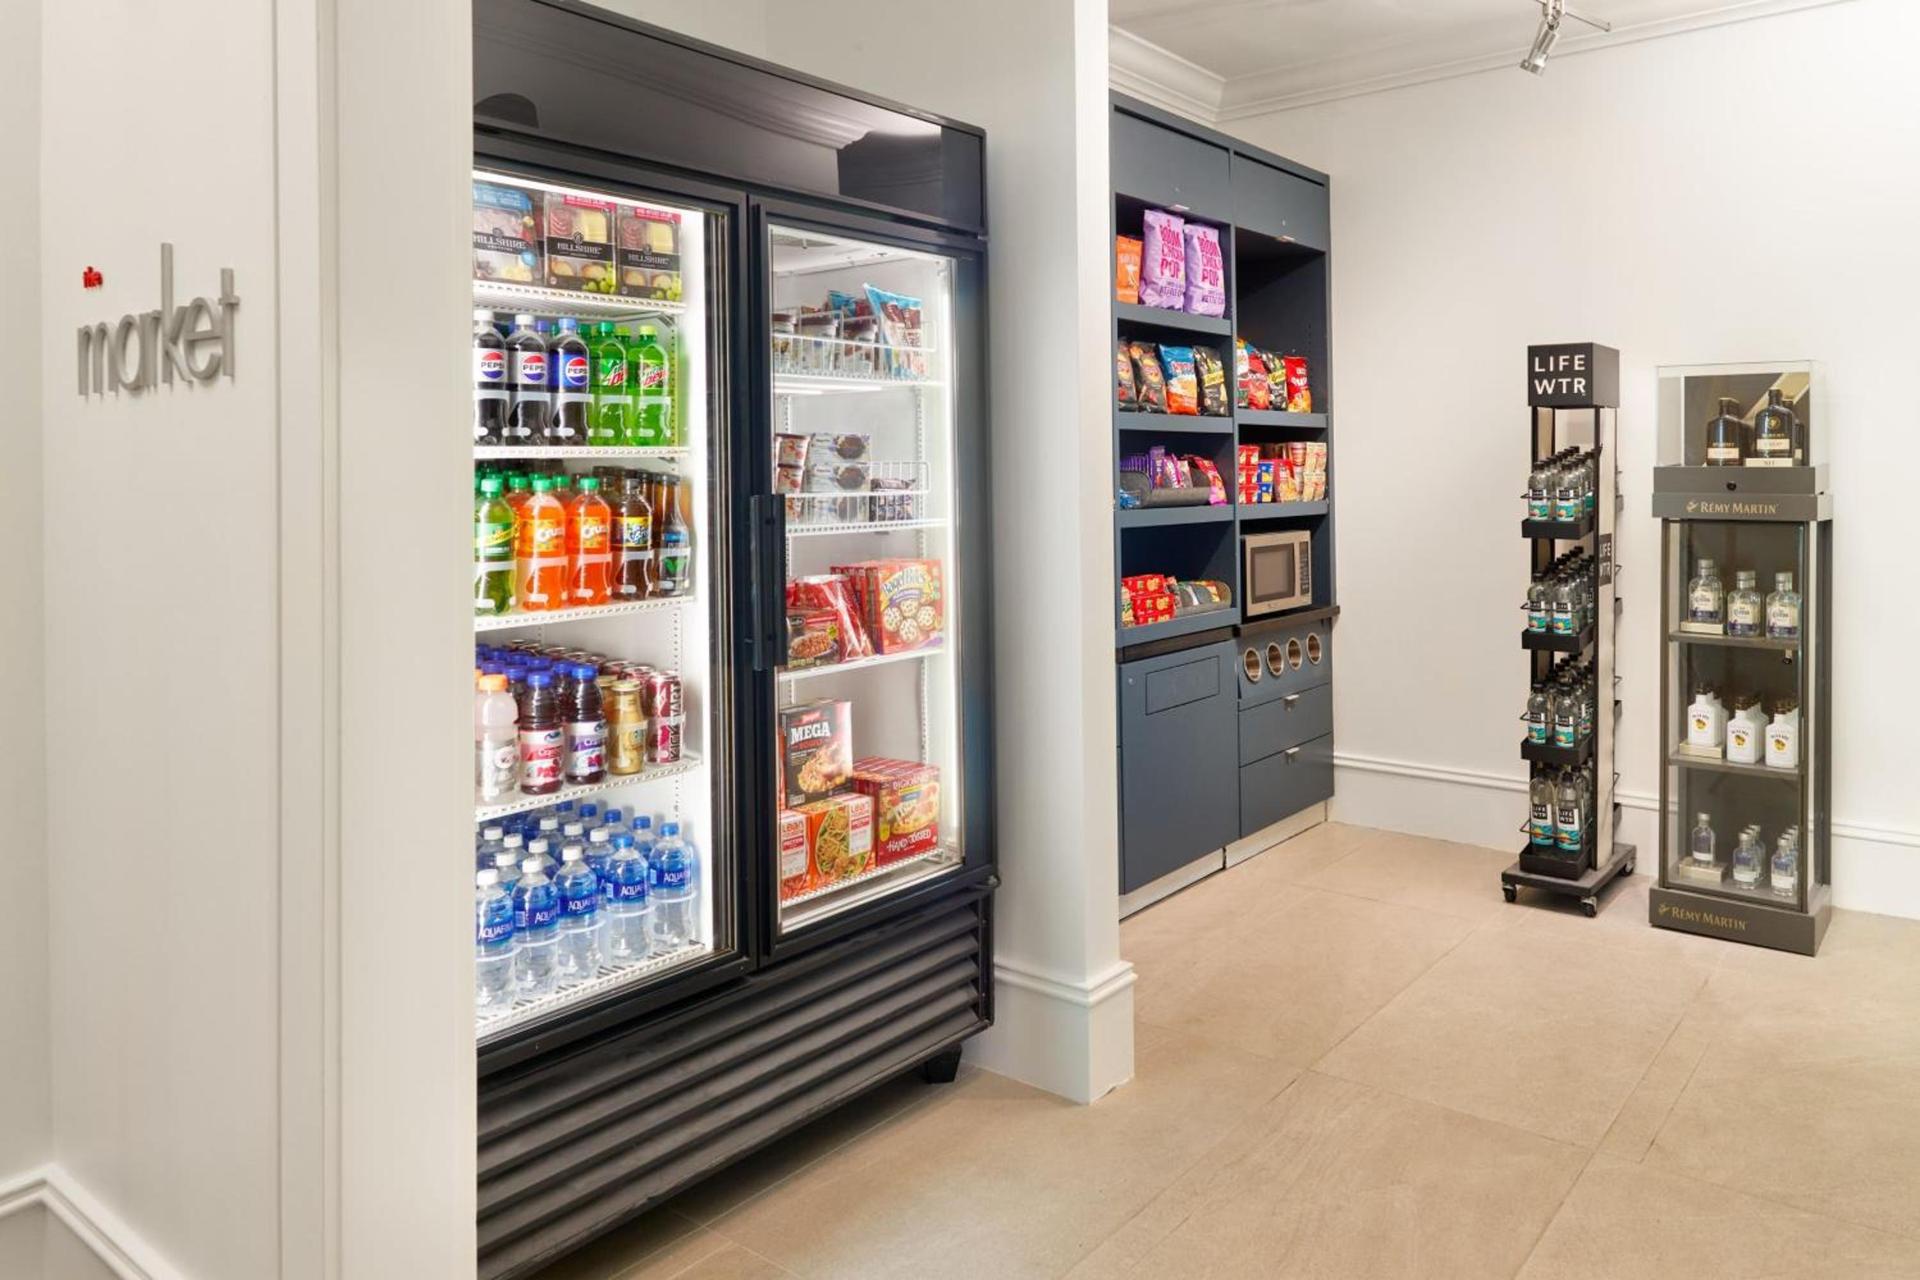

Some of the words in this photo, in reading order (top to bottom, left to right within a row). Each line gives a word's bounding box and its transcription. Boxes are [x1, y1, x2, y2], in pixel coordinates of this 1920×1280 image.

[78, 243, 240, 396] market
[480, 361, 505, 370] PEPS
[567, 367, 588, 375] PEPS
[1534, 354, 1586, 372] LIFE
[1534, 378, 1587, 395] WTR
[1700, 501, 1730, 513] RÉMY
[1732, 503, 1777, 515] MARTIN
[790, 721, 831, 745] MEGA
[1702, 912, 1747, 931] MARTIN
